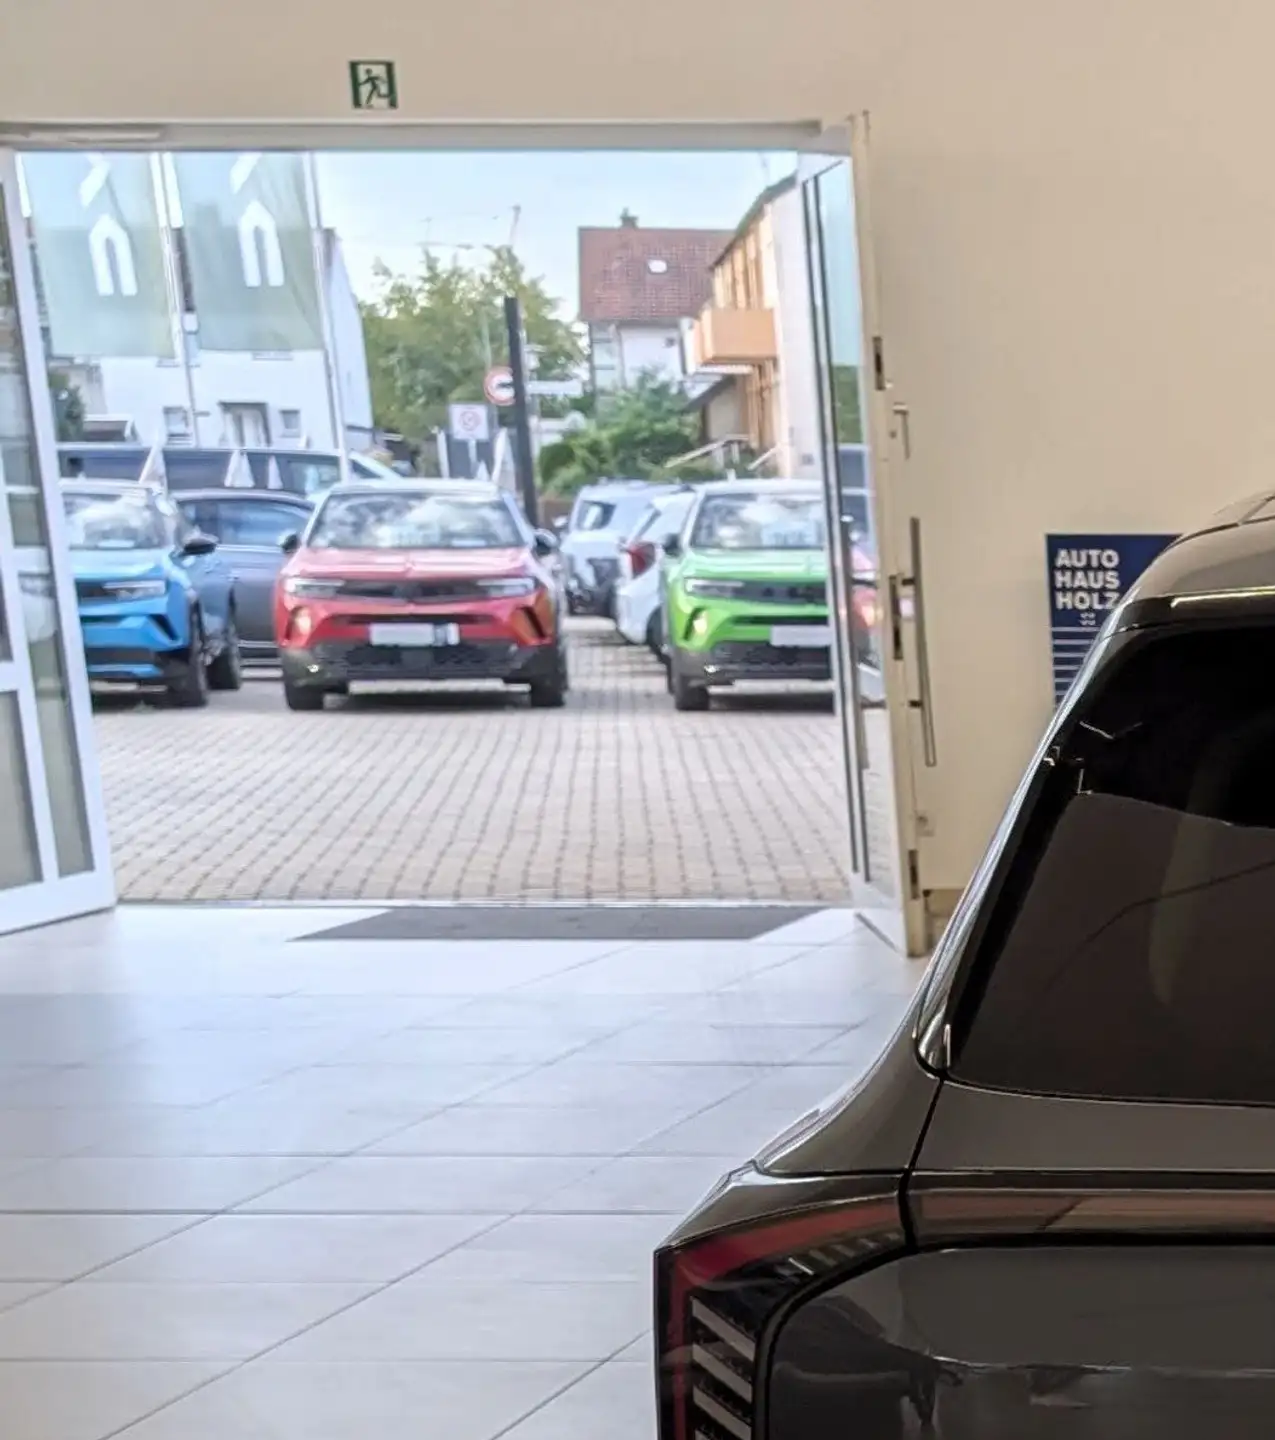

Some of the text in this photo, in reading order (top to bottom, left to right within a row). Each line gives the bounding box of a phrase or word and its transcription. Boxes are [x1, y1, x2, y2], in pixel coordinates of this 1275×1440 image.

[1055, 548, 1119, 568] AUTO
[1054, 570, 1120, 589] HAUS
[1055, 591, 1119, 610] HOLZ
